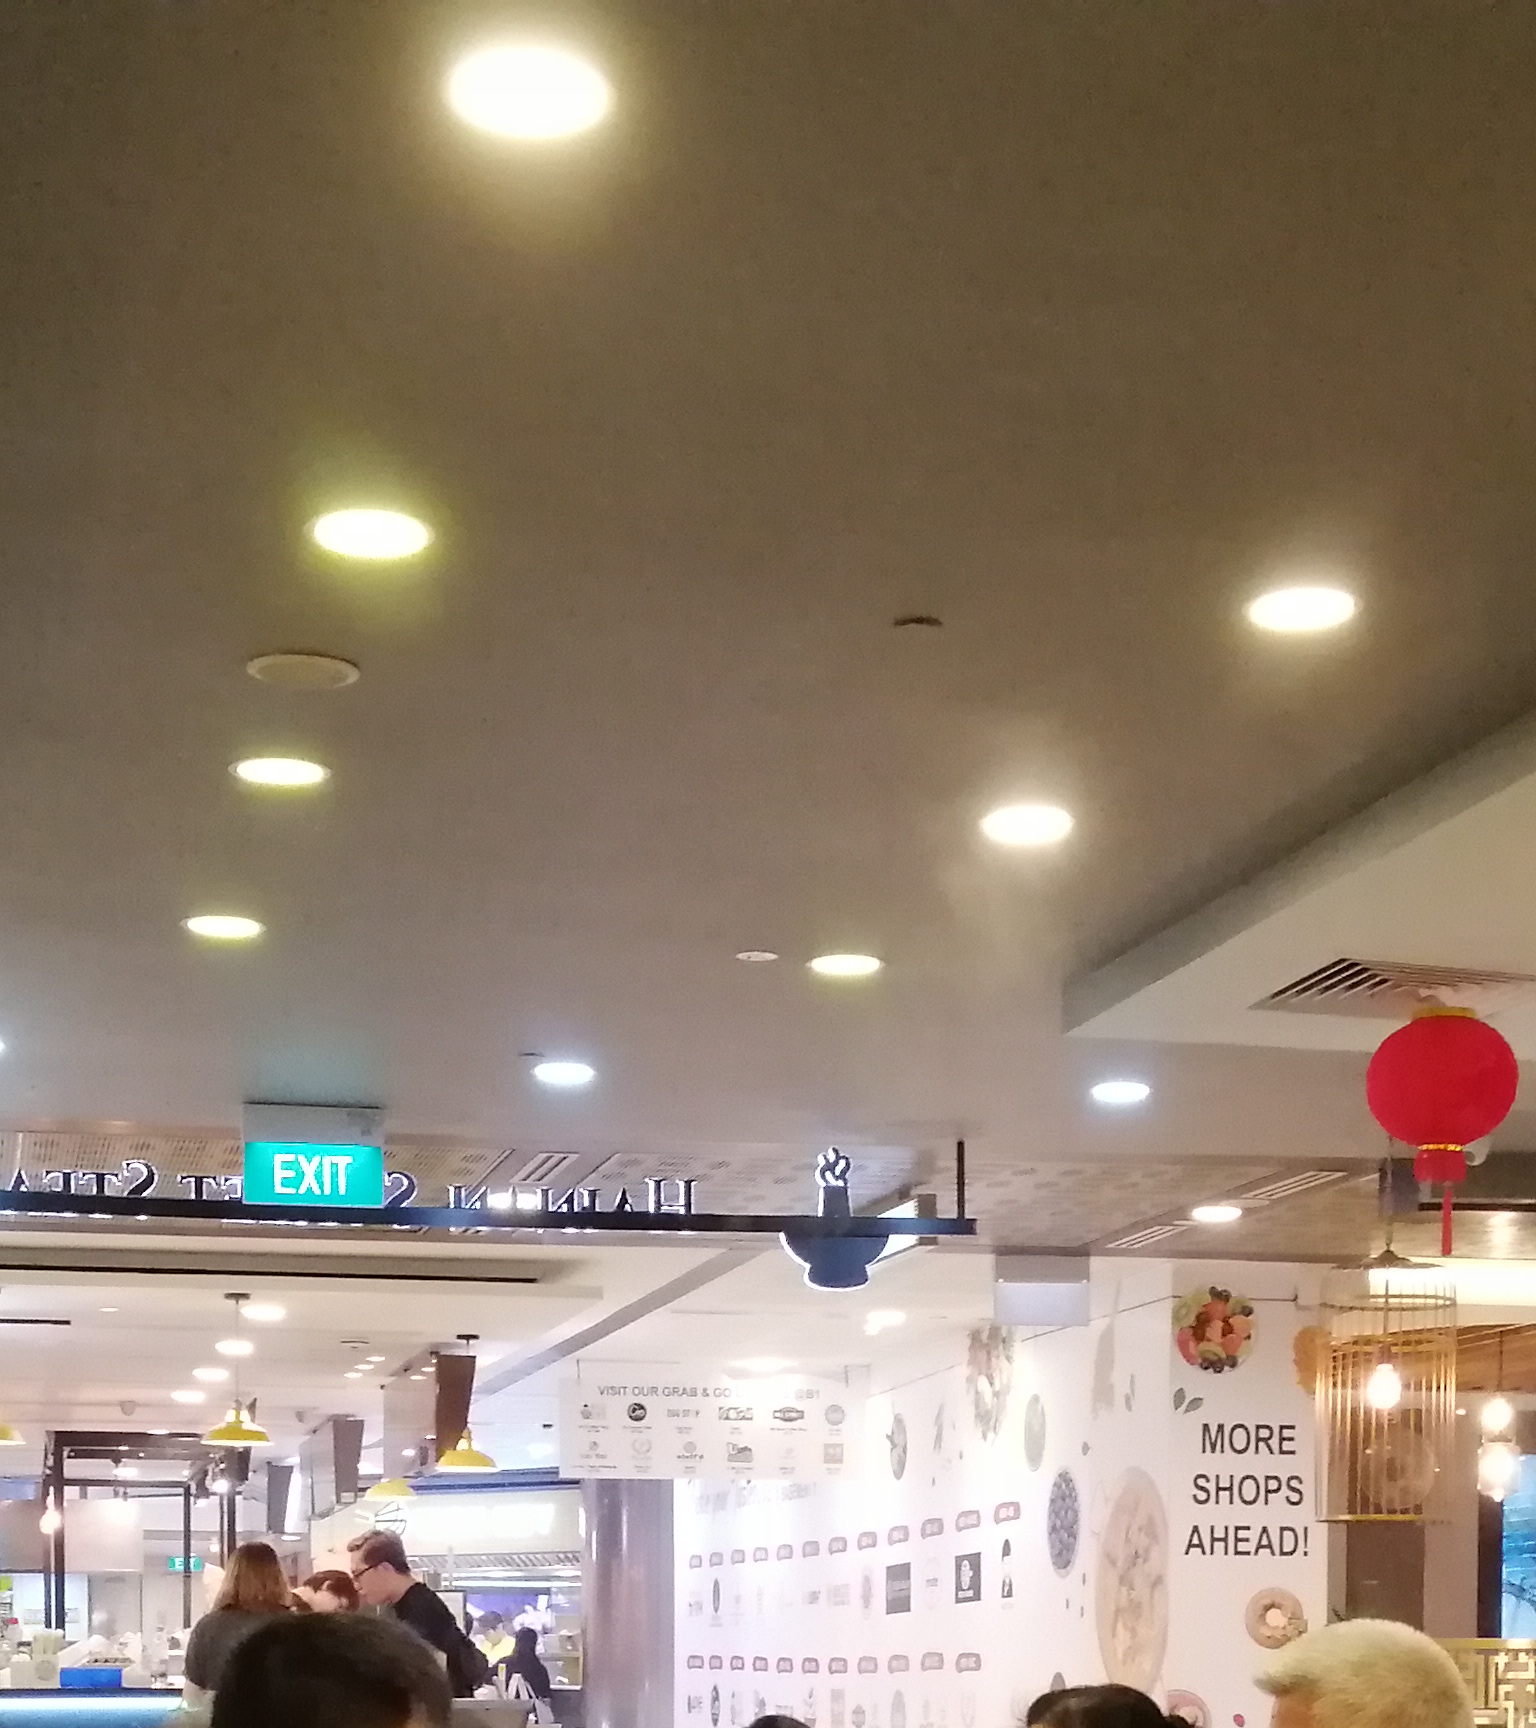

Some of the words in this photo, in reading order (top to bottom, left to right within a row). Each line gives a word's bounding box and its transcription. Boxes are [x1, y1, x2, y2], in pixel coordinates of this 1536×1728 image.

[273, 1153, 354, 1196] EXIT
[598, 1385, 628, 1397] VISIT
[632, 1386, 660, 1398] OUR
[662, 1386, 699, 1398] GRAB
[702, 1387, 711, 1398] &
[713, 1388, 732, 1399] GO
[1201, 1423, 1297, 1455] MORE
[1192, 1474, 1304, 1506] SHOPS
[1184, 1525, 1309, 1557] AHEAD!
